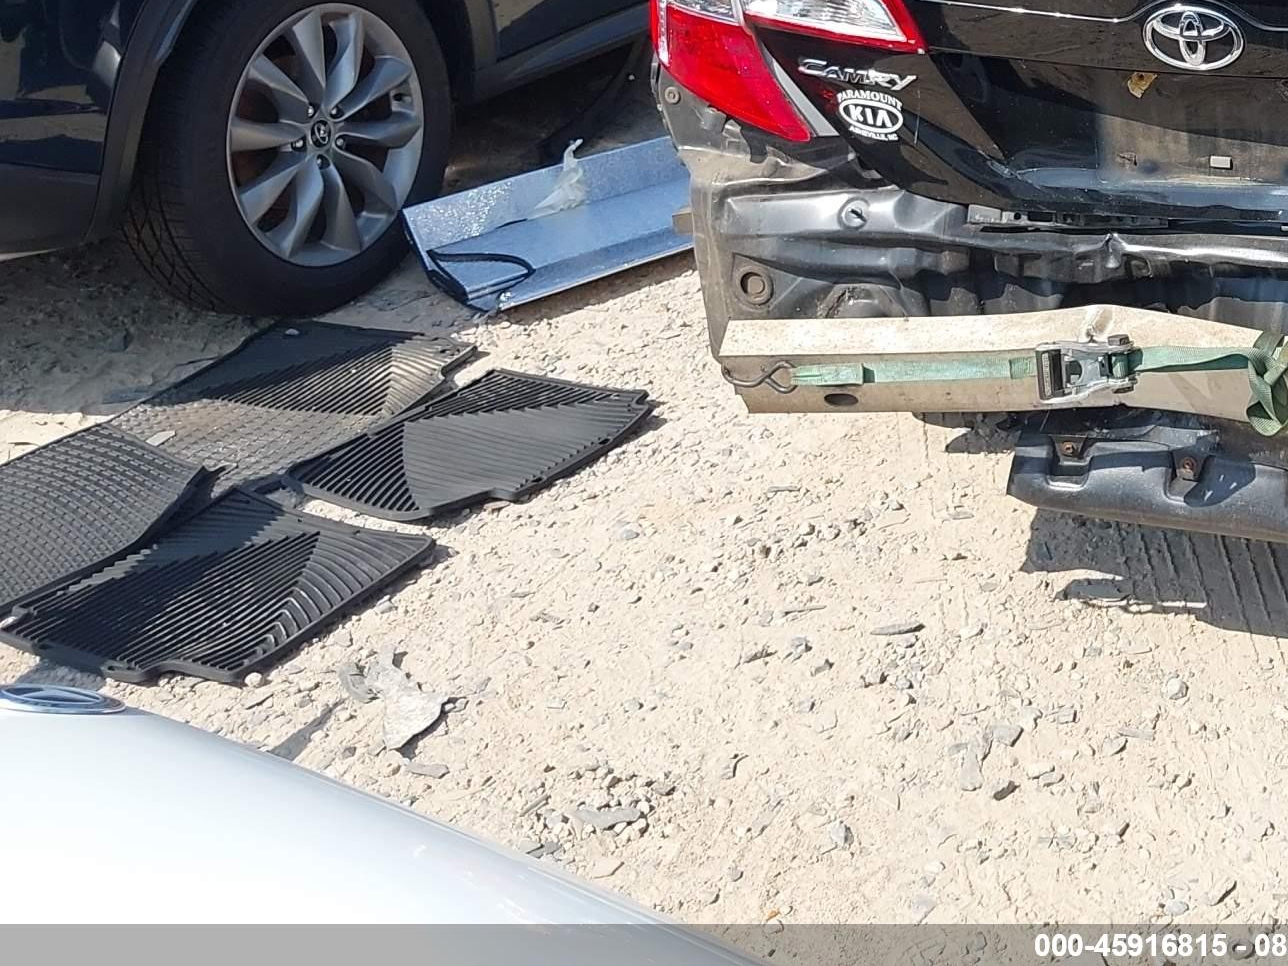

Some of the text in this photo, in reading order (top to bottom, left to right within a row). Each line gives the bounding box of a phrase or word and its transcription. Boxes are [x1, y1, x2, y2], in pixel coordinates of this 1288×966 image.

[798, 58, 918, 91] CAMRY
[836, 89, 903, 111] PARAMOUNT
[848, 104, 894, 128] KIA
